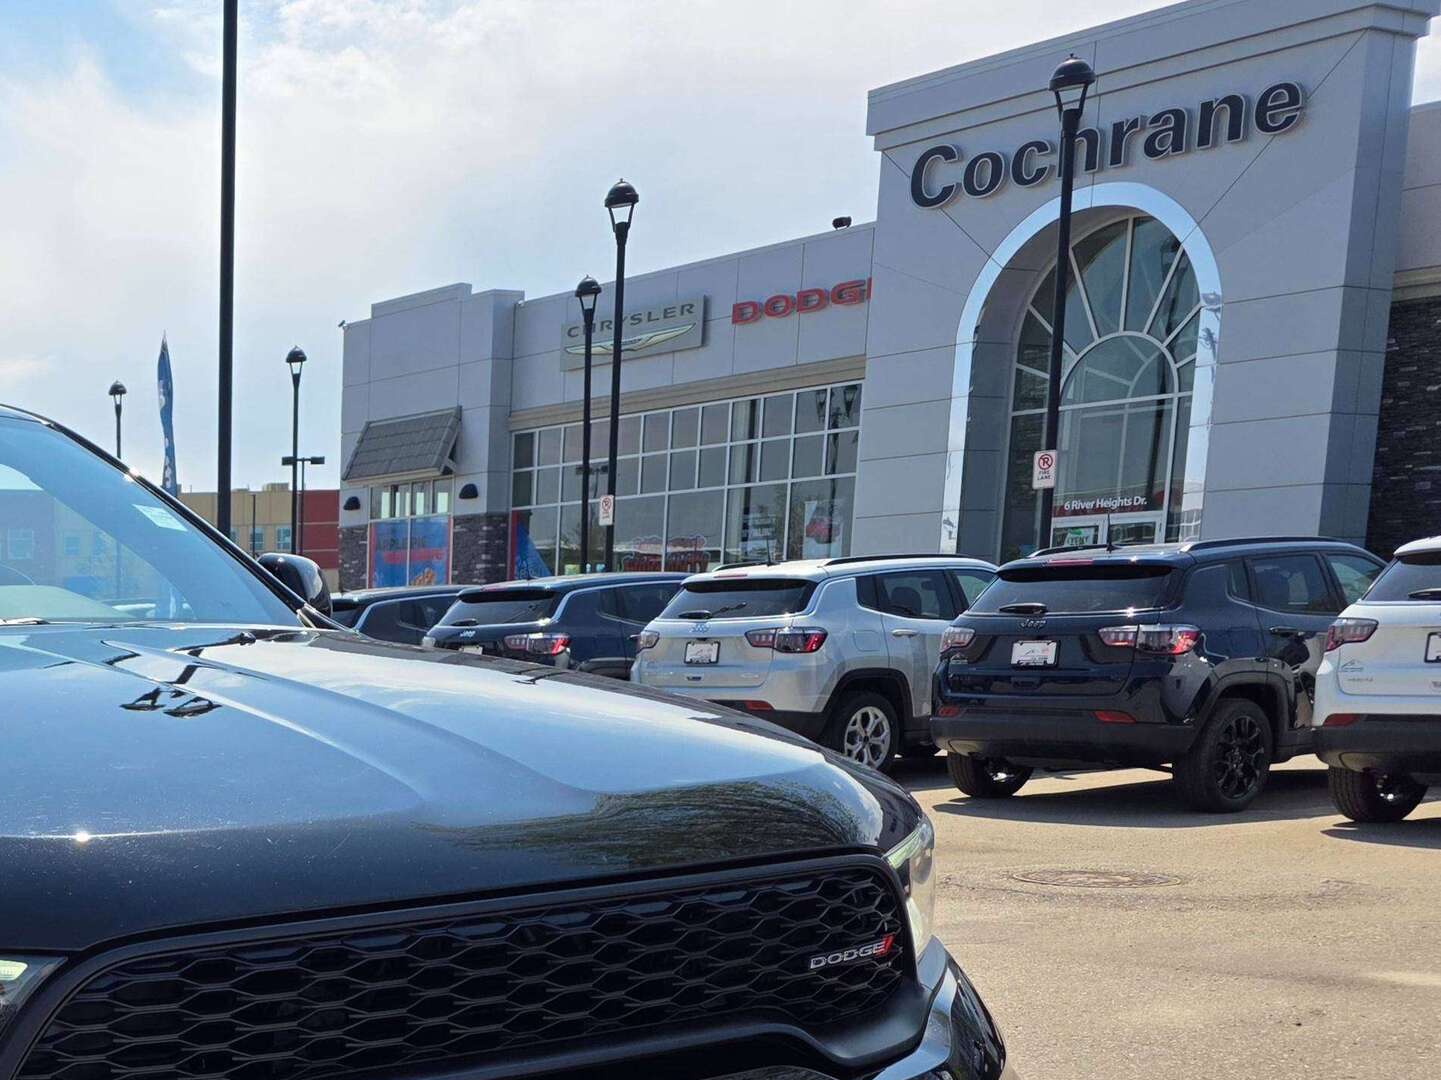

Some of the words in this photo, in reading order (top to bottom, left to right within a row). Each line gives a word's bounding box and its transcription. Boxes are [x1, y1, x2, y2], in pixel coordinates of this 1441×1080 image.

[910, 80, 1303, 209] Cochrane
[732, 276, 872, 324] DODG
[567, 303, 695, 338] CHRSLER
[1064, 502, 1070, 510] 6
[1071, 500, 1095, 510] River
[1096, 498, 1132, 511] Heights
[1133, 496, 1148, 506] Dr.
[810, 941, 886, 969] DODGE
